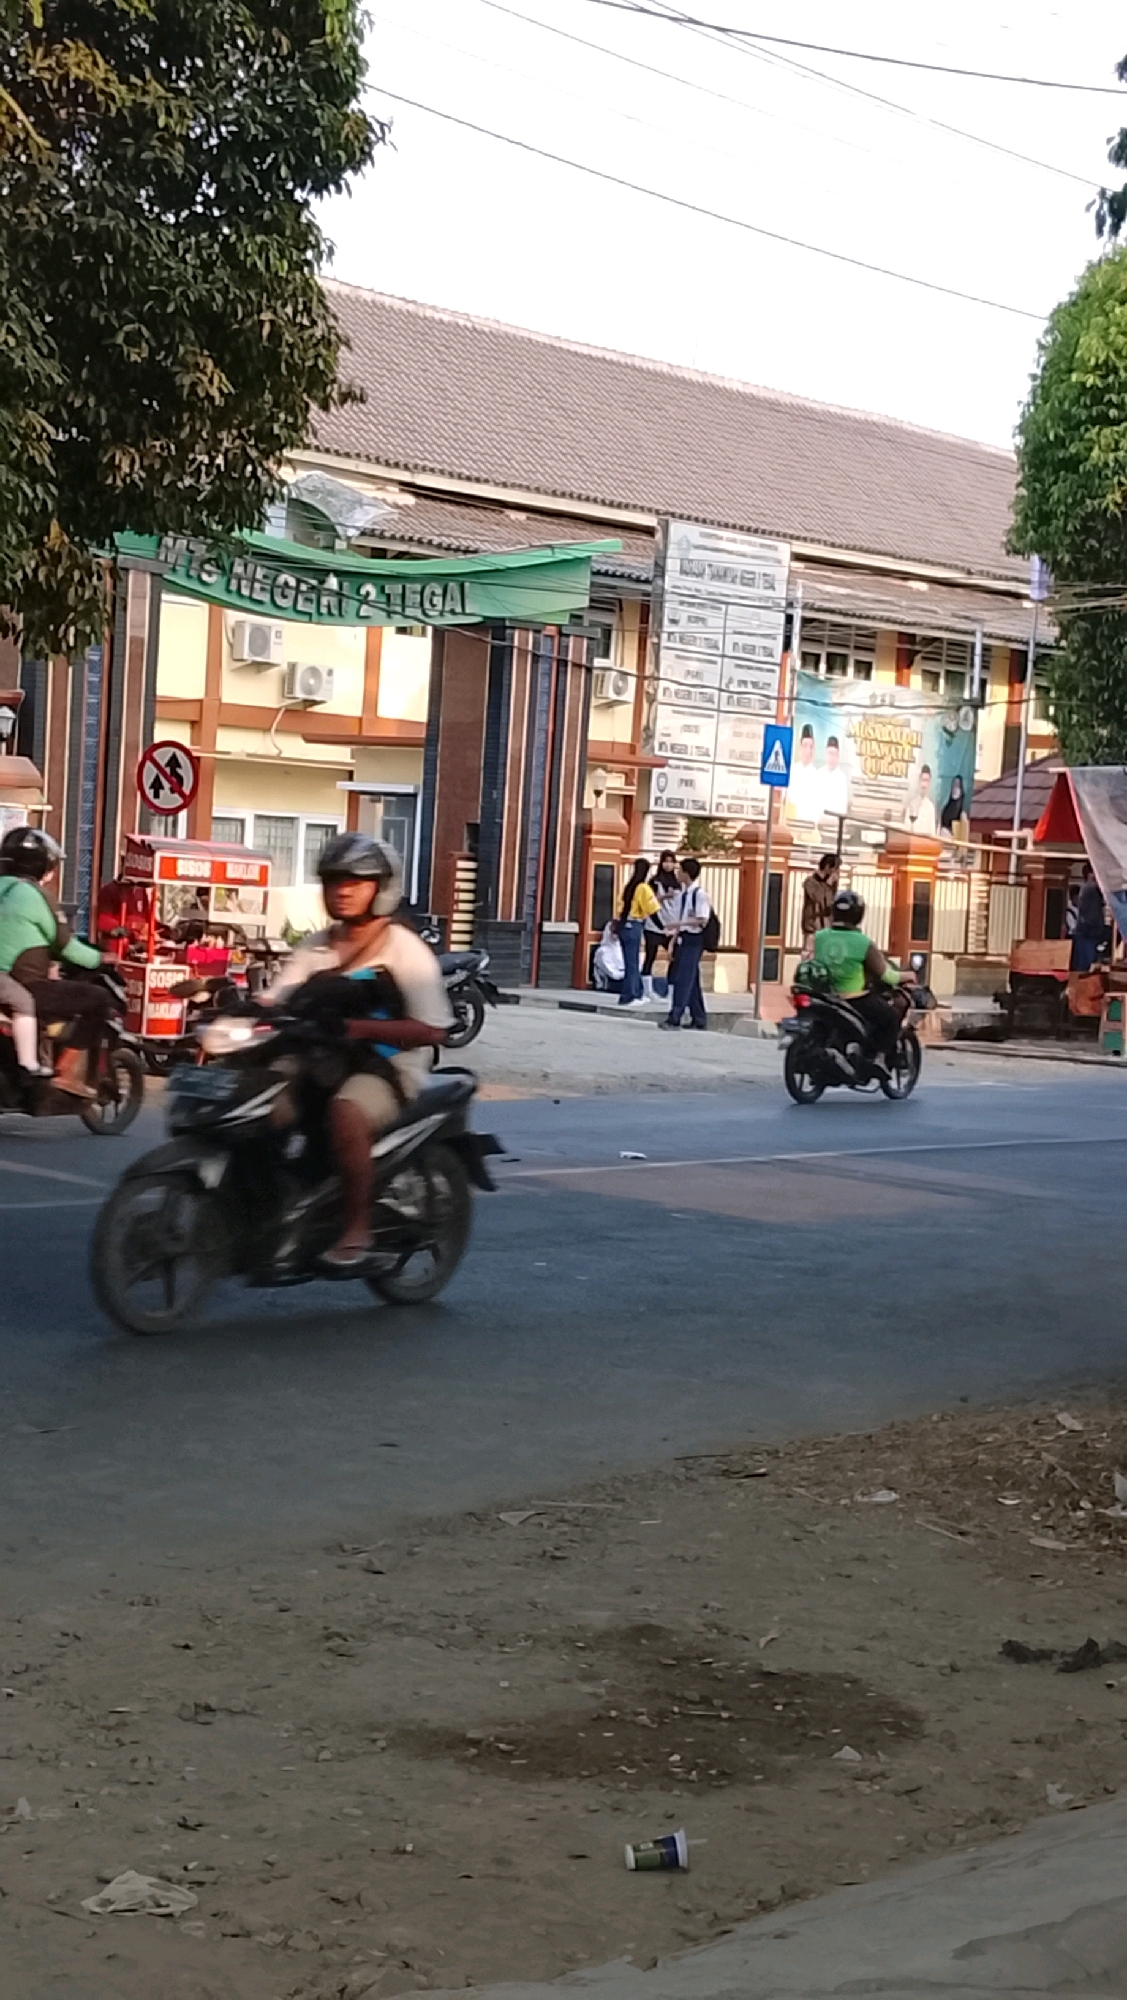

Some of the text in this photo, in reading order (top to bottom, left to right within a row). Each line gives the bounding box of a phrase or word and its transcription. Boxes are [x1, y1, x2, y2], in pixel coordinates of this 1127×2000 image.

[228, 556, 349, 617] NEGERI
[359, 582, 377, 617] 2
[384, 582, 475, 618] TEGAL
